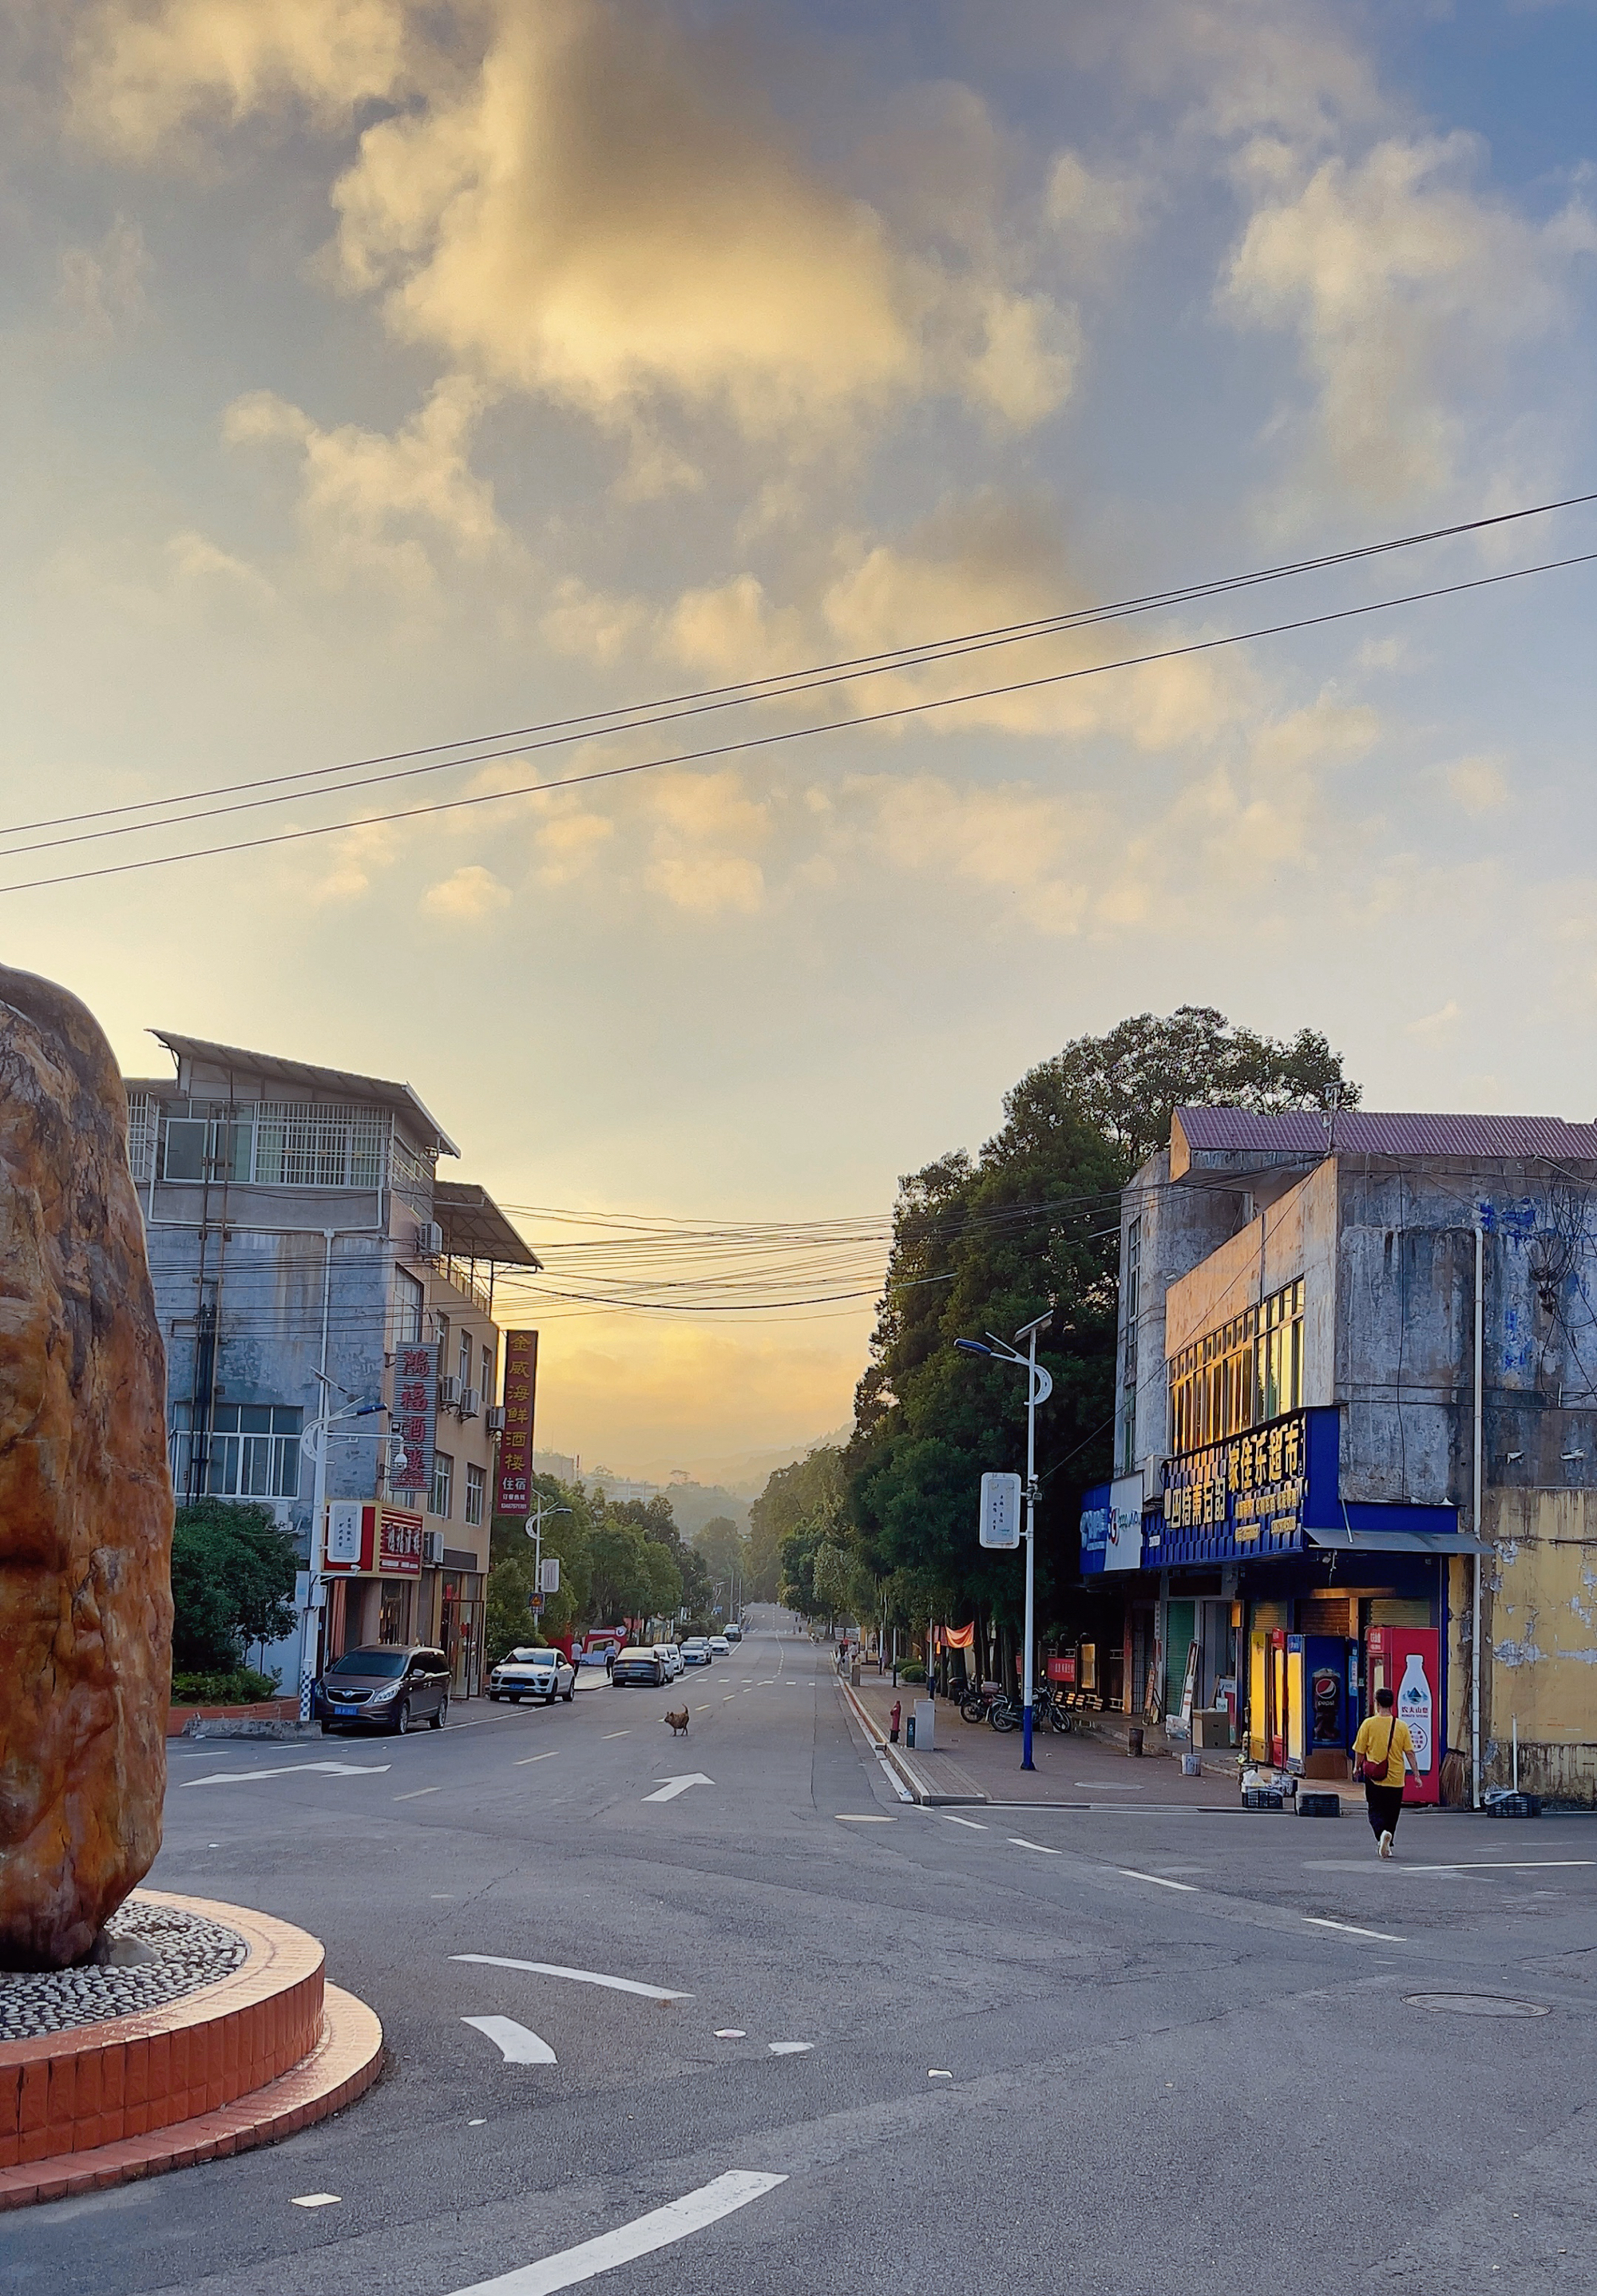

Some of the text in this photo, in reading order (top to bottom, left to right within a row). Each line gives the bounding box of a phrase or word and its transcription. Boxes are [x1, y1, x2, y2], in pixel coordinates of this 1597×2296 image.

[505, 1334, 532, 1472] 金威海鲜酒楼
[502, 1477, 527, 1490] 住宿
[1228, 1418, 1300, 1493] 家佳乐超市
